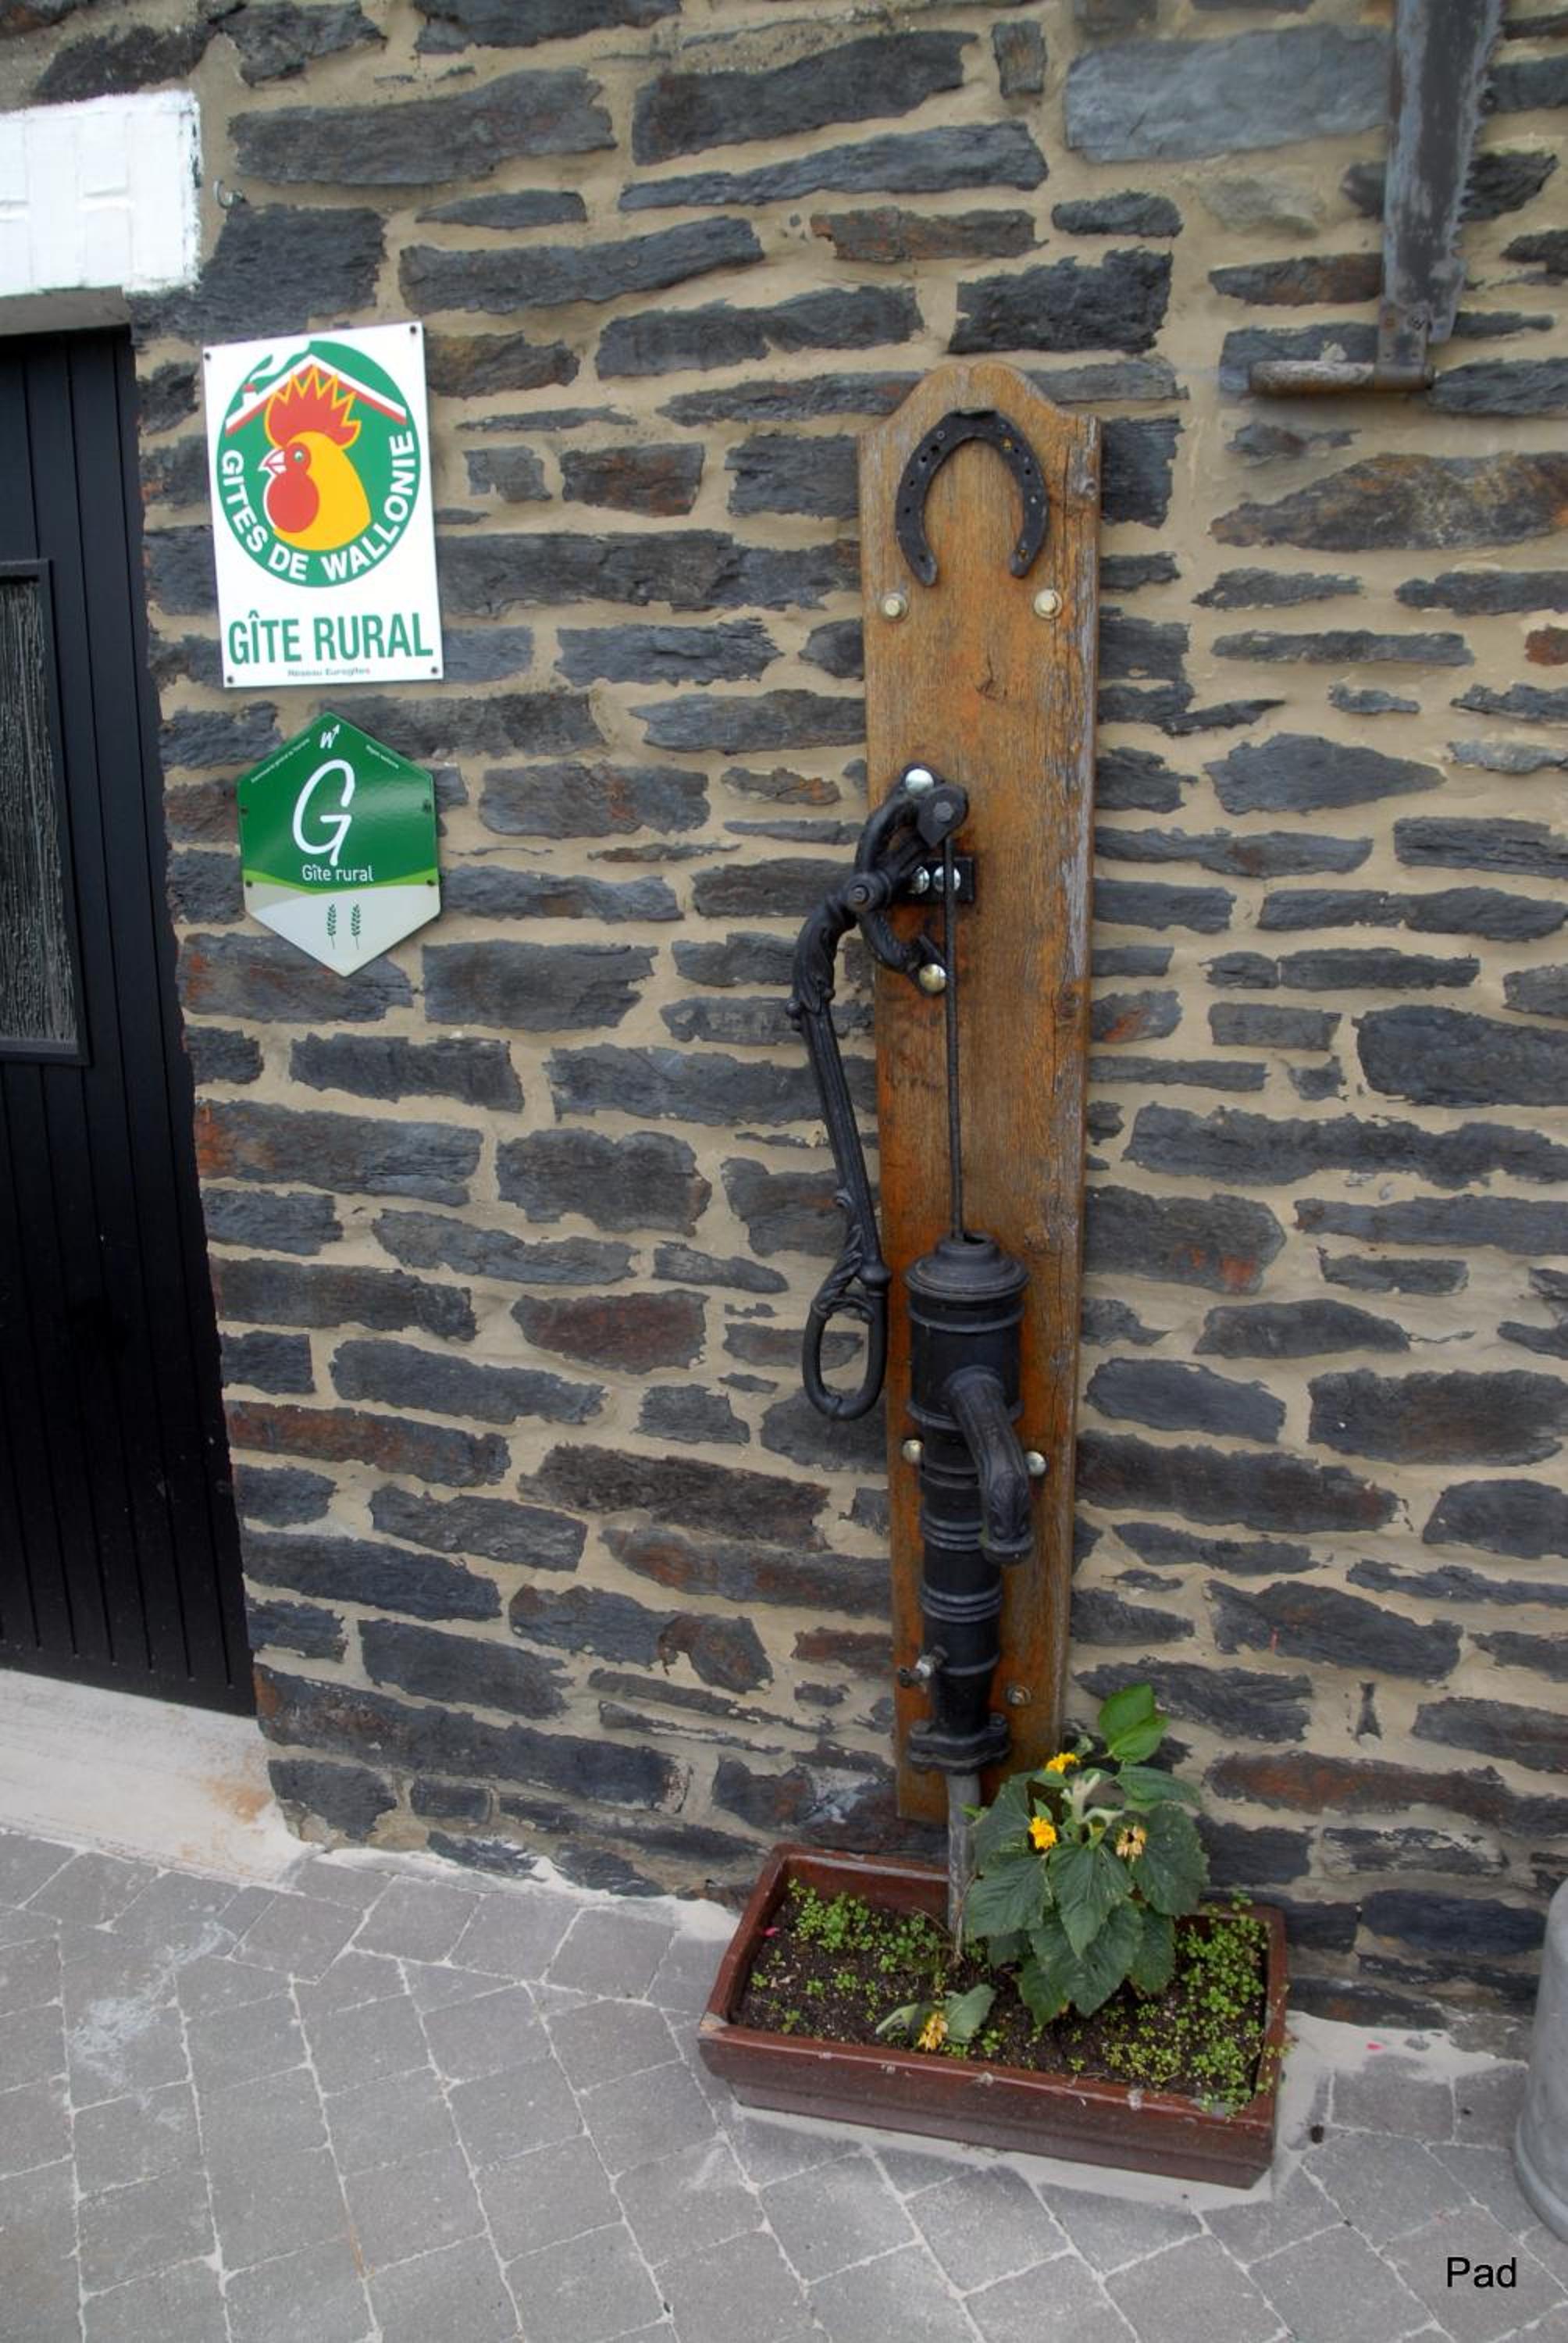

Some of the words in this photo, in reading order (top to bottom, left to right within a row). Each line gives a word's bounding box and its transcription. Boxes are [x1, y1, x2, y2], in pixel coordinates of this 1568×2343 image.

[222, 450, 268, 551] GITES
[269, 544, 308, 581] DE
[321, 430, 415, 582] WALLONIE
[228, 610, 301, 665] GÎTE
[313, 612, 433, 661] RURAL
[293, 759, 355, 866] G
[336, 865, 374, 881] rural
